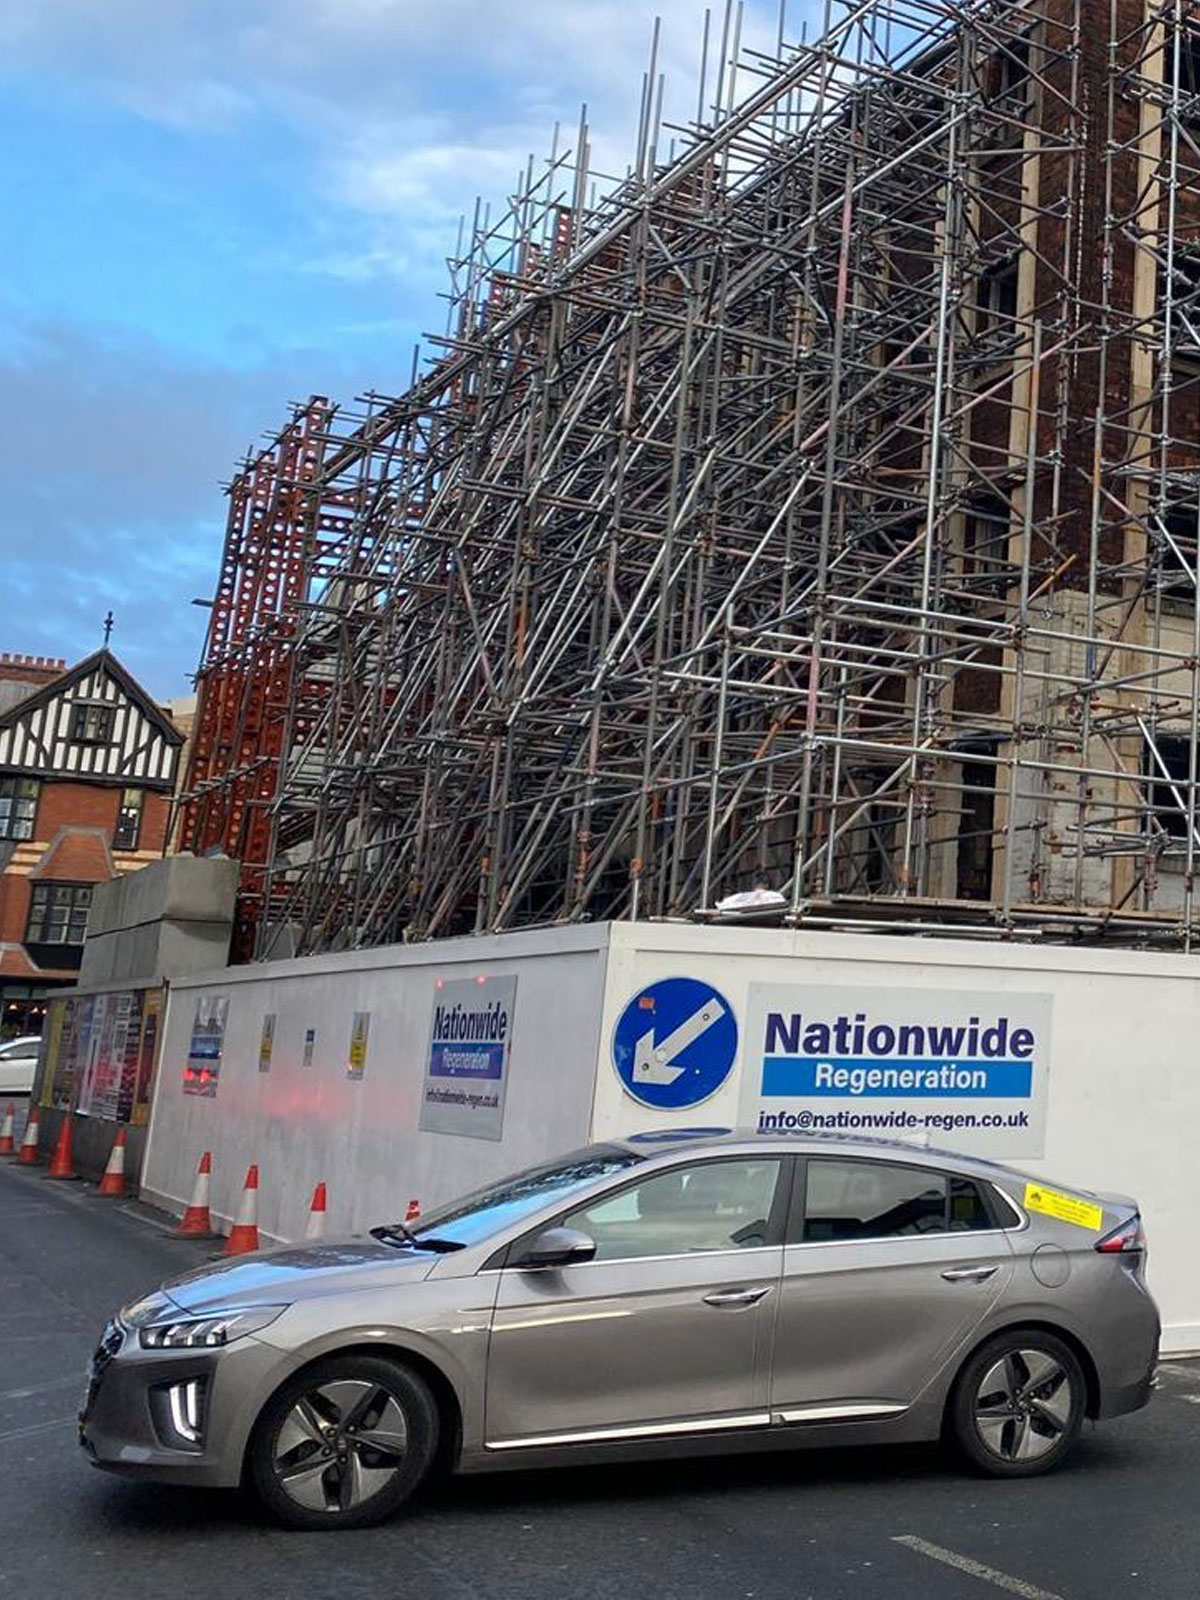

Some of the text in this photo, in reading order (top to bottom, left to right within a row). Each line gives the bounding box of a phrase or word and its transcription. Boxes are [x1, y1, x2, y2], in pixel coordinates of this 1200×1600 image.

[432, 1002, 507, 1041] Nationwide
[764, 1013, 1035, 1058] Nationwide
[443, 1048, 490, 1073] Regeneration
[814, 1063, 987, 1094] Regeneration
[758, 1111, 1029, 1131] info@nationwide-regen.co.uk
